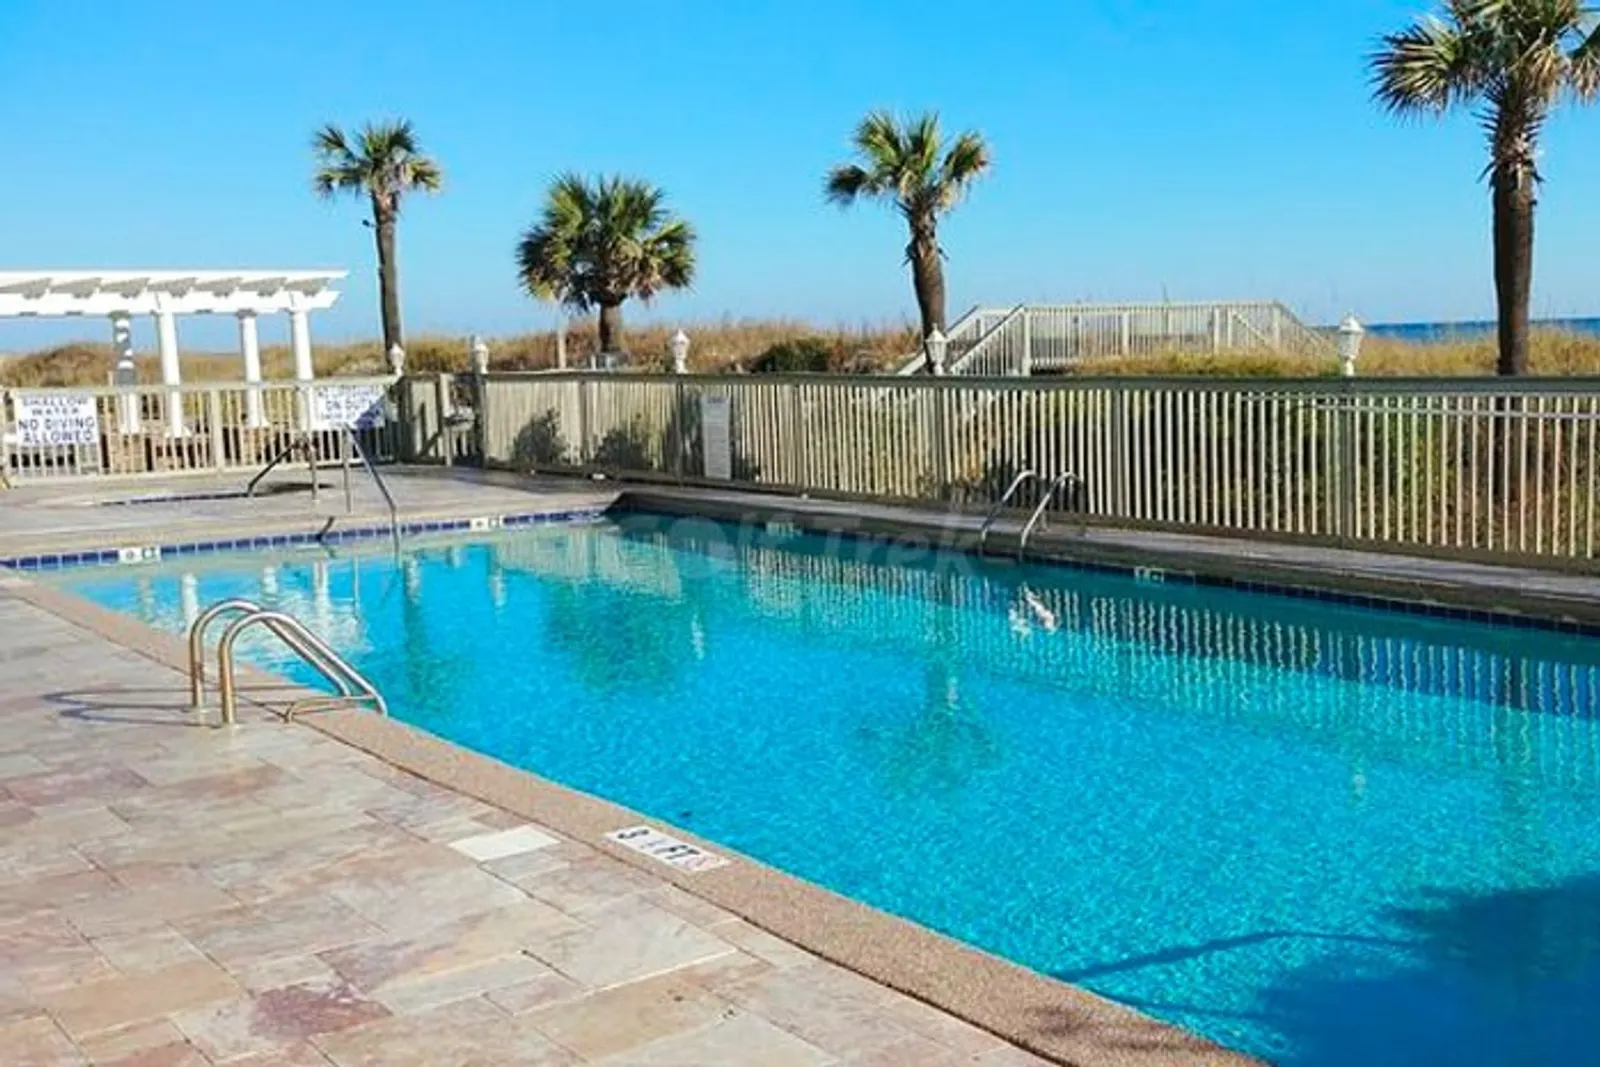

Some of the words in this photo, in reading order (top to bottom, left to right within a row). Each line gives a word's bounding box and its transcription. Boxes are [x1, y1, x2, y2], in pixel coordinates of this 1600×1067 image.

[18, 418, 39, 431] NO
[44, 416, 95, 431] DIVING
[23, 430, 93, 444] ALLOWED
